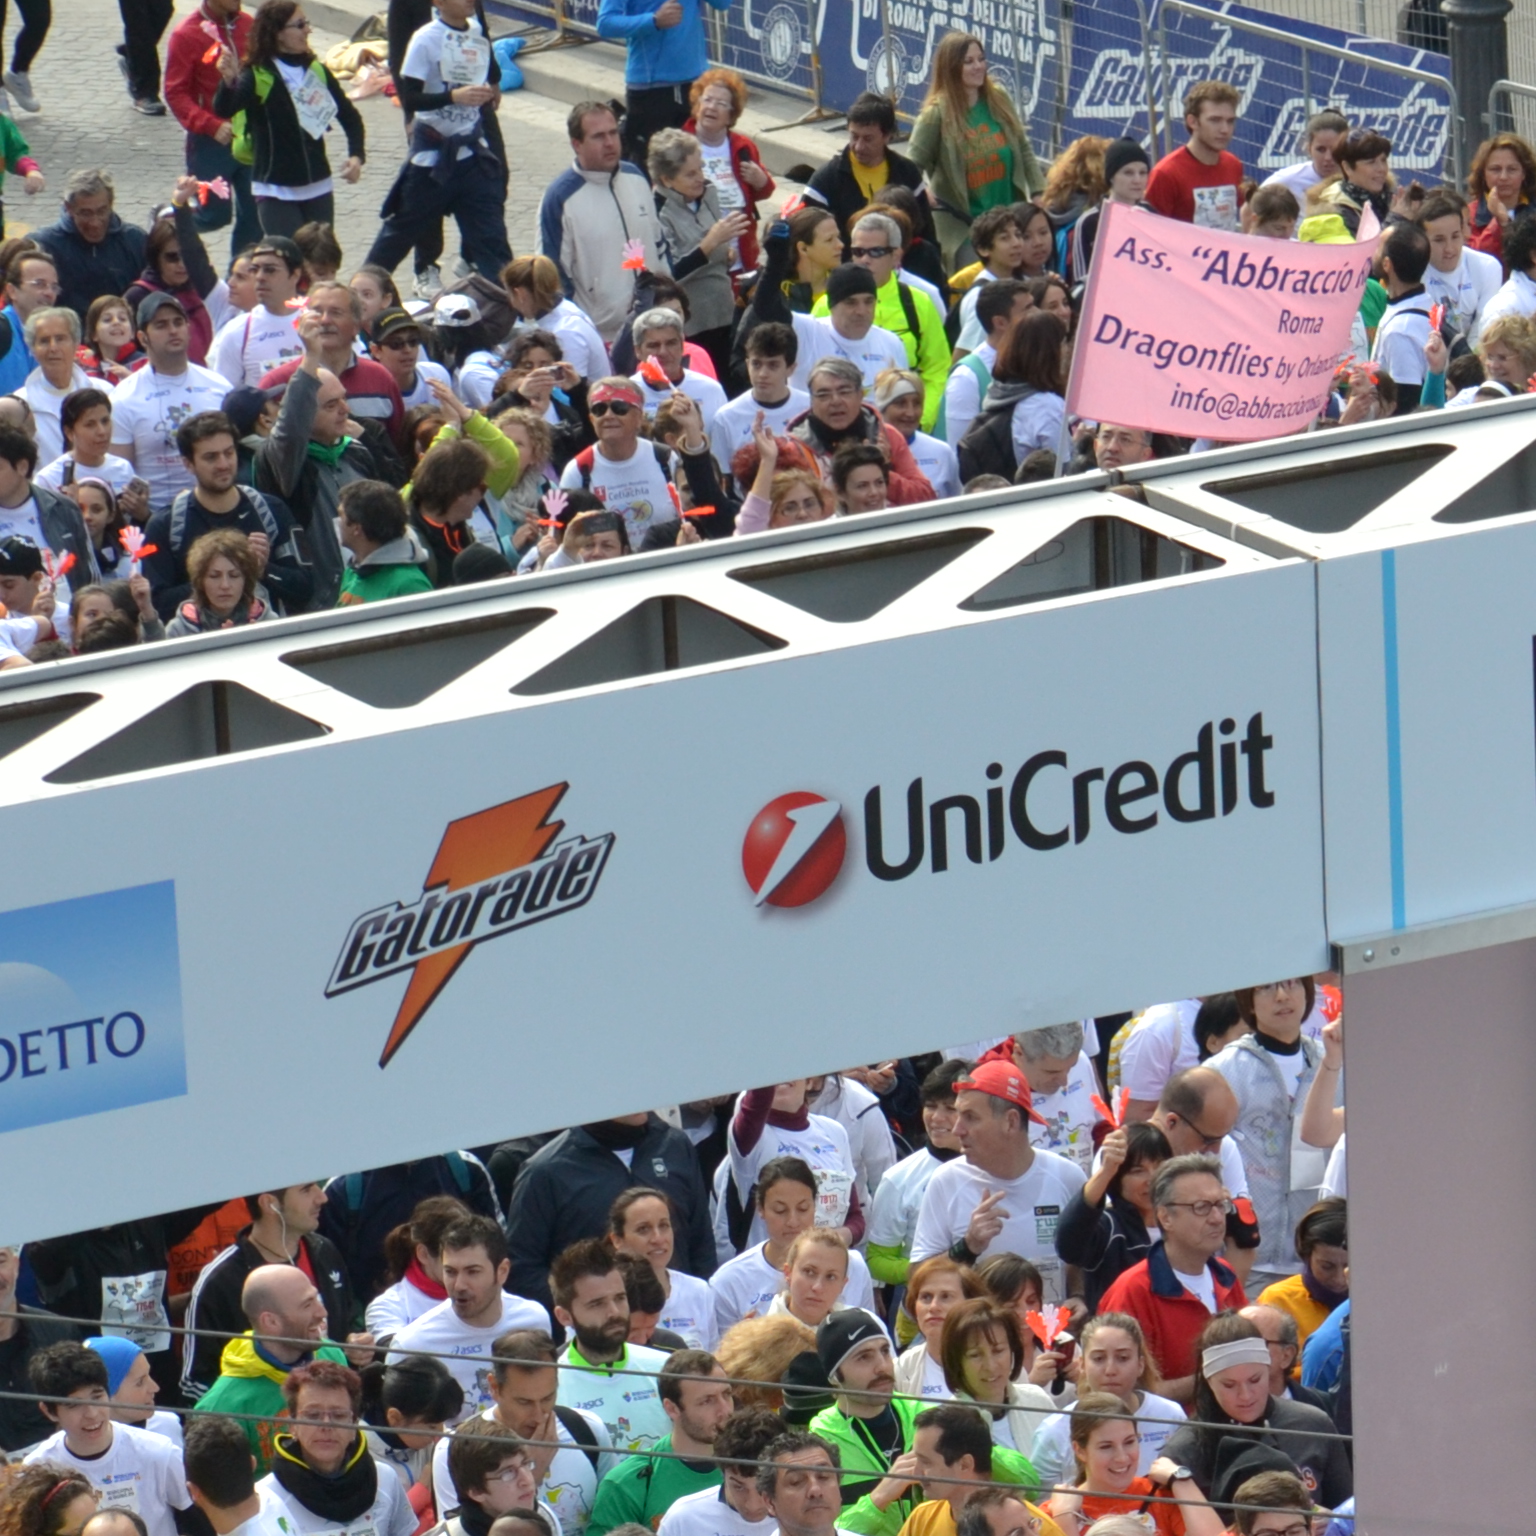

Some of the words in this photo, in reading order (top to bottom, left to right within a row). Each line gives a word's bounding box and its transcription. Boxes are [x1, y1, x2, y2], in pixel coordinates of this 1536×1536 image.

[1114, 236, 1172, 272] Ass.
[1278, 309, 1324, 335] Roma
[1093, 313, 1273, 378] Dragonflies
[1275, 359, 1296, 386] by
[863, 710, 1275, 882] UniCredit
[335, 838, 607, 984] Gatorade
[460, 1343, 483, 1355] asics
